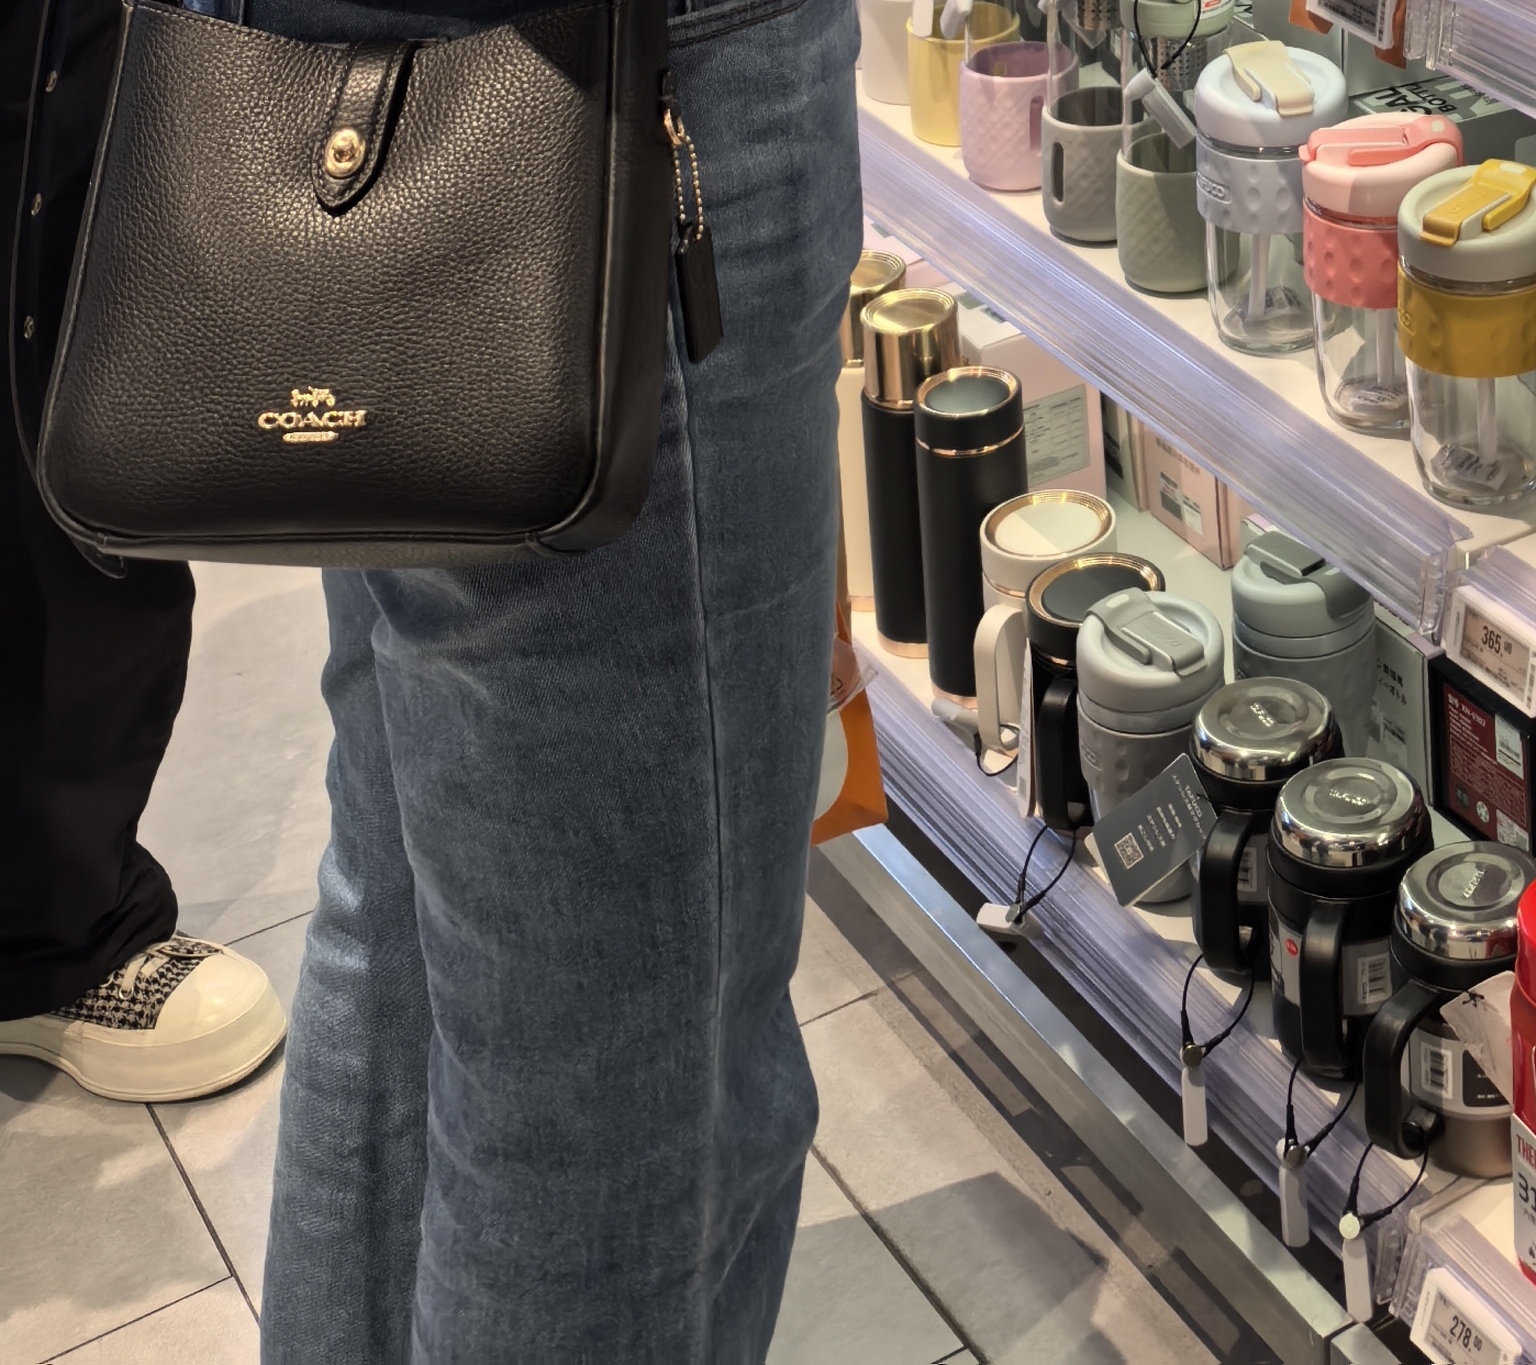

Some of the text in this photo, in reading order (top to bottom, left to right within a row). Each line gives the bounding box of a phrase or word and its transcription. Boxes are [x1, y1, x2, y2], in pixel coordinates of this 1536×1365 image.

[257, 409, 367, 432] COACH
[1480, 623, 1513, 656] 365.00
[1449, 1314, 1484, 1352] 278.00
